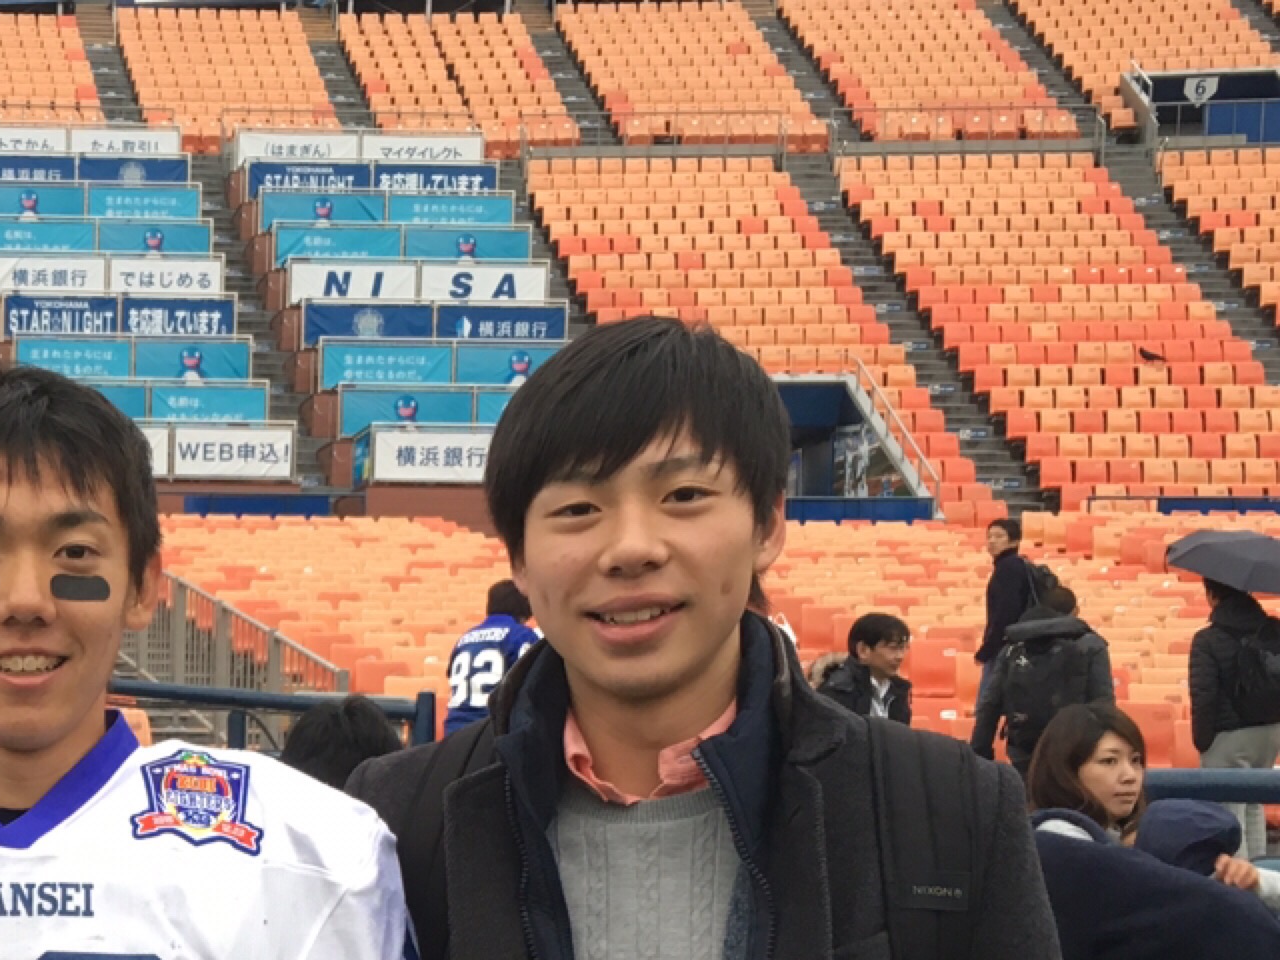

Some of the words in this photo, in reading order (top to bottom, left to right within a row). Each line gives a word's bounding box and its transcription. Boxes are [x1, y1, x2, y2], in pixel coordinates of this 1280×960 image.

[1195, 79, 1206, 96] 6
[380, 146, 463, 160] マイダイレクト
[11, 268, 88, 288] 横浜銀行
[120, 271, 212, 289] ではじめる
[478, 320, 548, 339] 横浜銀行
[177, 441, 289, 464] WEB申込!
[396, 445, 487, 467] 横浜銀行
